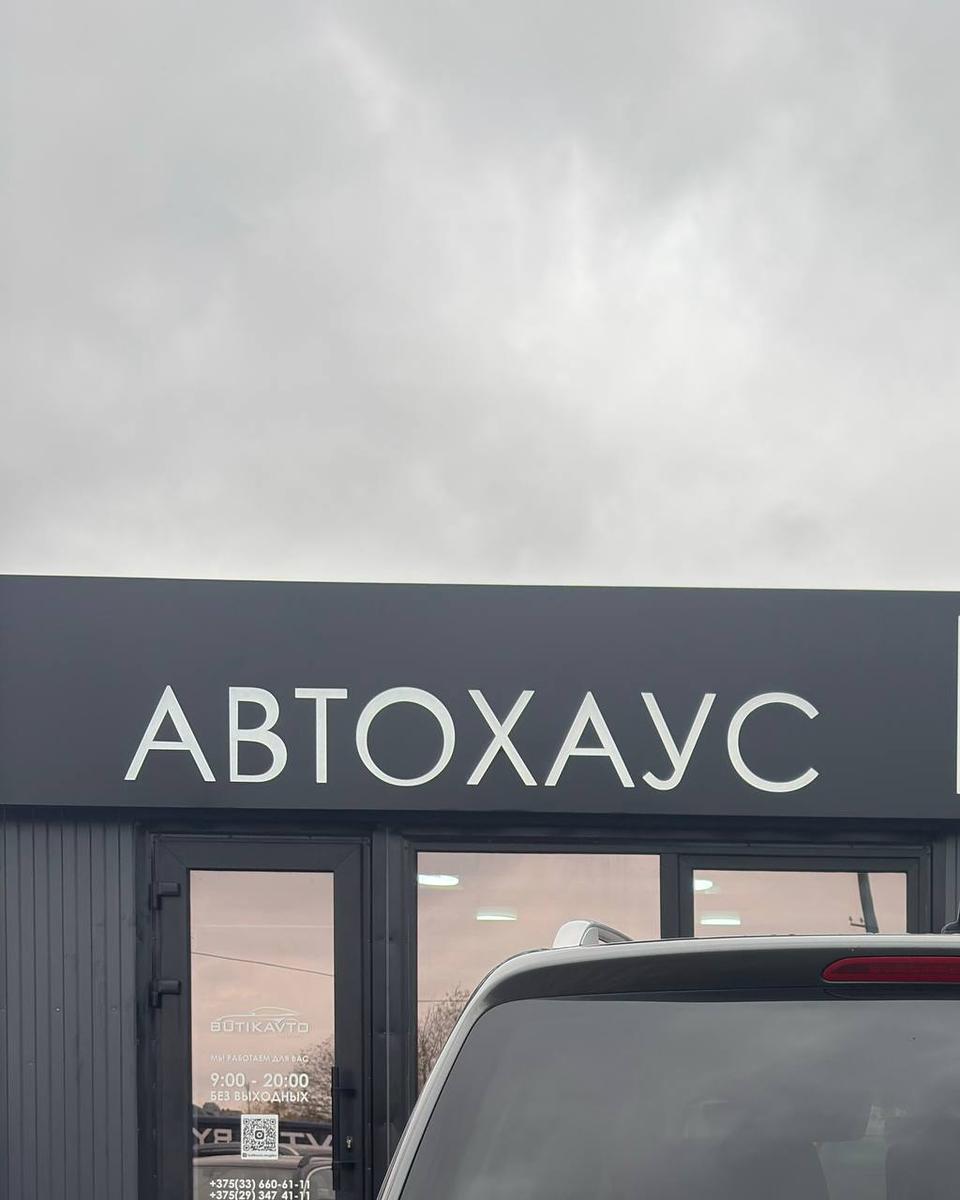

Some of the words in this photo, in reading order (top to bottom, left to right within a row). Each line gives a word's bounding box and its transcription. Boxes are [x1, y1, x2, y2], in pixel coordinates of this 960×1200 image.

[124, 685, 819, 793] АВТОХАУС
[210, 1021, 309, 1033] BUTIKAVTO
[210, 1073, 245, 1088] 9:00
[263, 1073, 309, 1088] 20:00
[210, 1091, 231, 1101] БЕЗ
[234, 1091, 309, 1103] ВЫХОДНЫХ
[209, 1179, 256, 1191] +375(33)
[258, 1179, 310, 1189] 660-61-11
